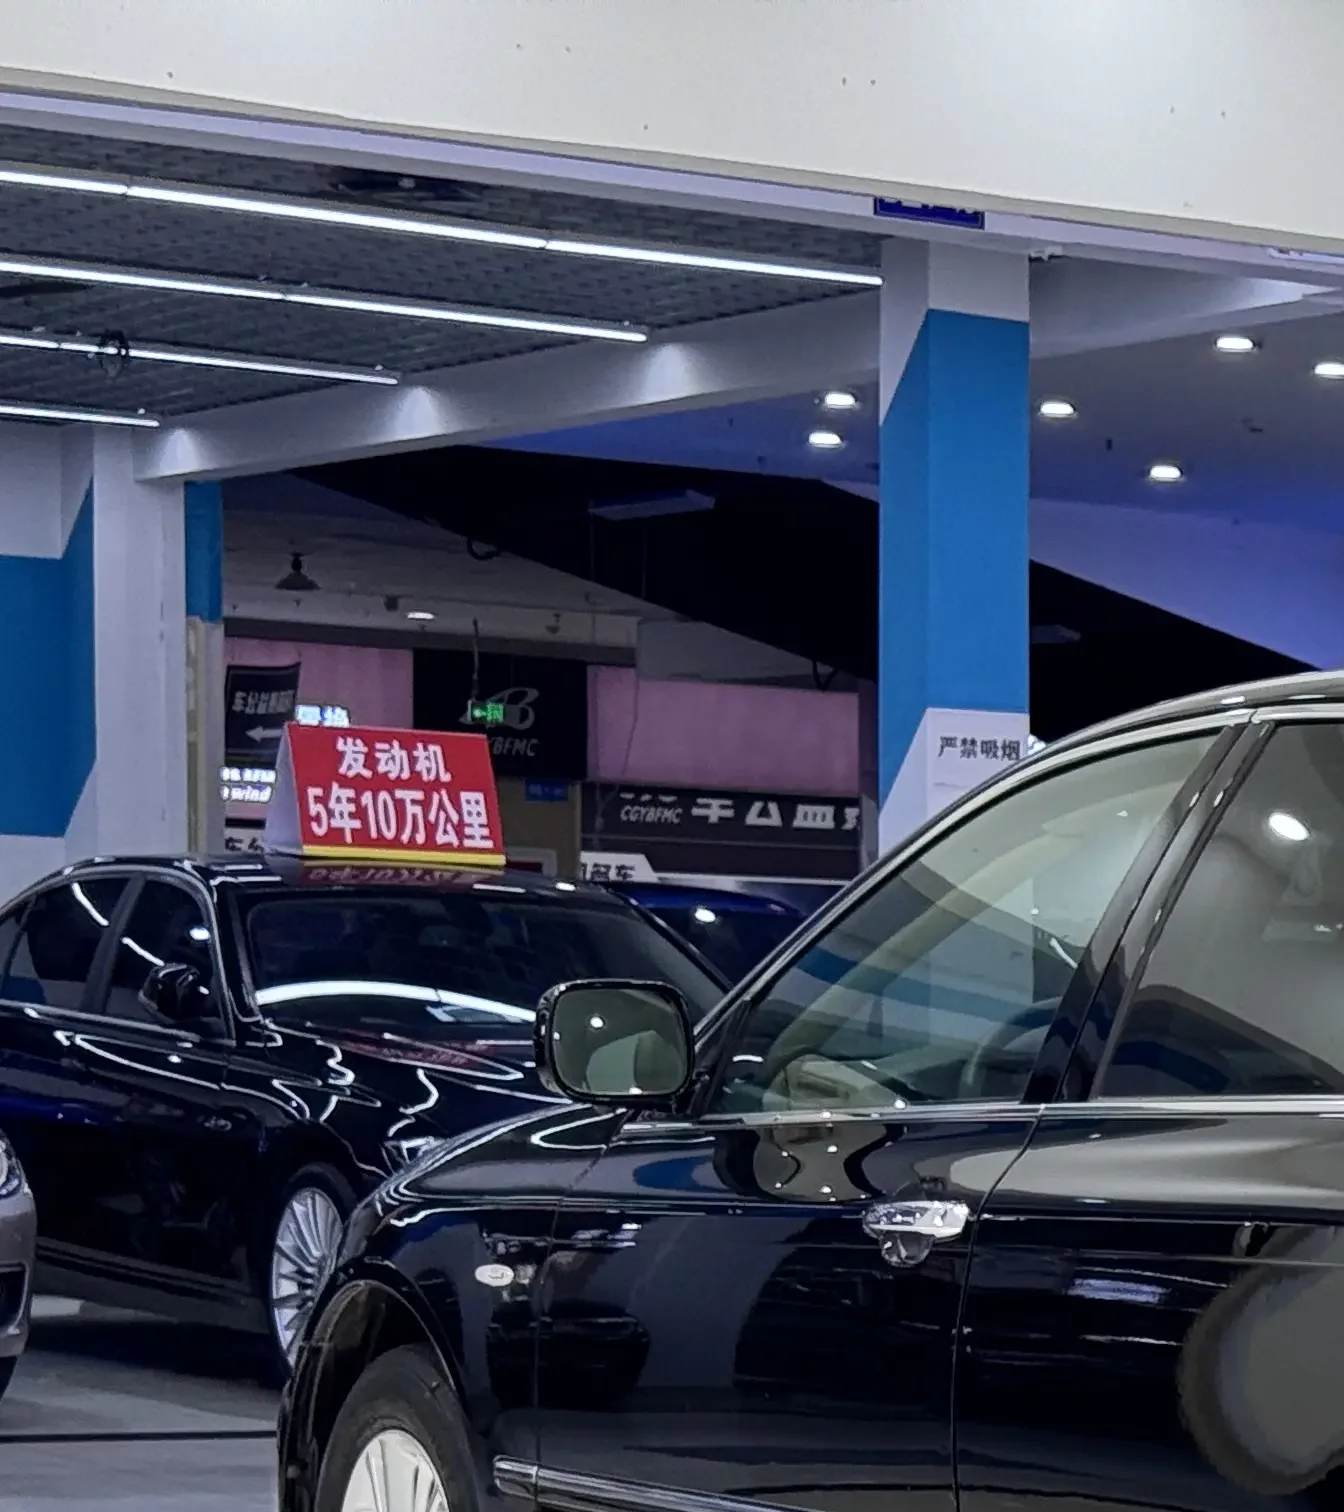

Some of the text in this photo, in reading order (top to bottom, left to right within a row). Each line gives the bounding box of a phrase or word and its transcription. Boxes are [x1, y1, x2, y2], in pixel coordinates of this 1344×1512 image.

[336, 735, 452, 784] 发动机
[937, 735, 1021, 762] 严禁吸烟
[307, 781, 494, 849] 5年10万公里
